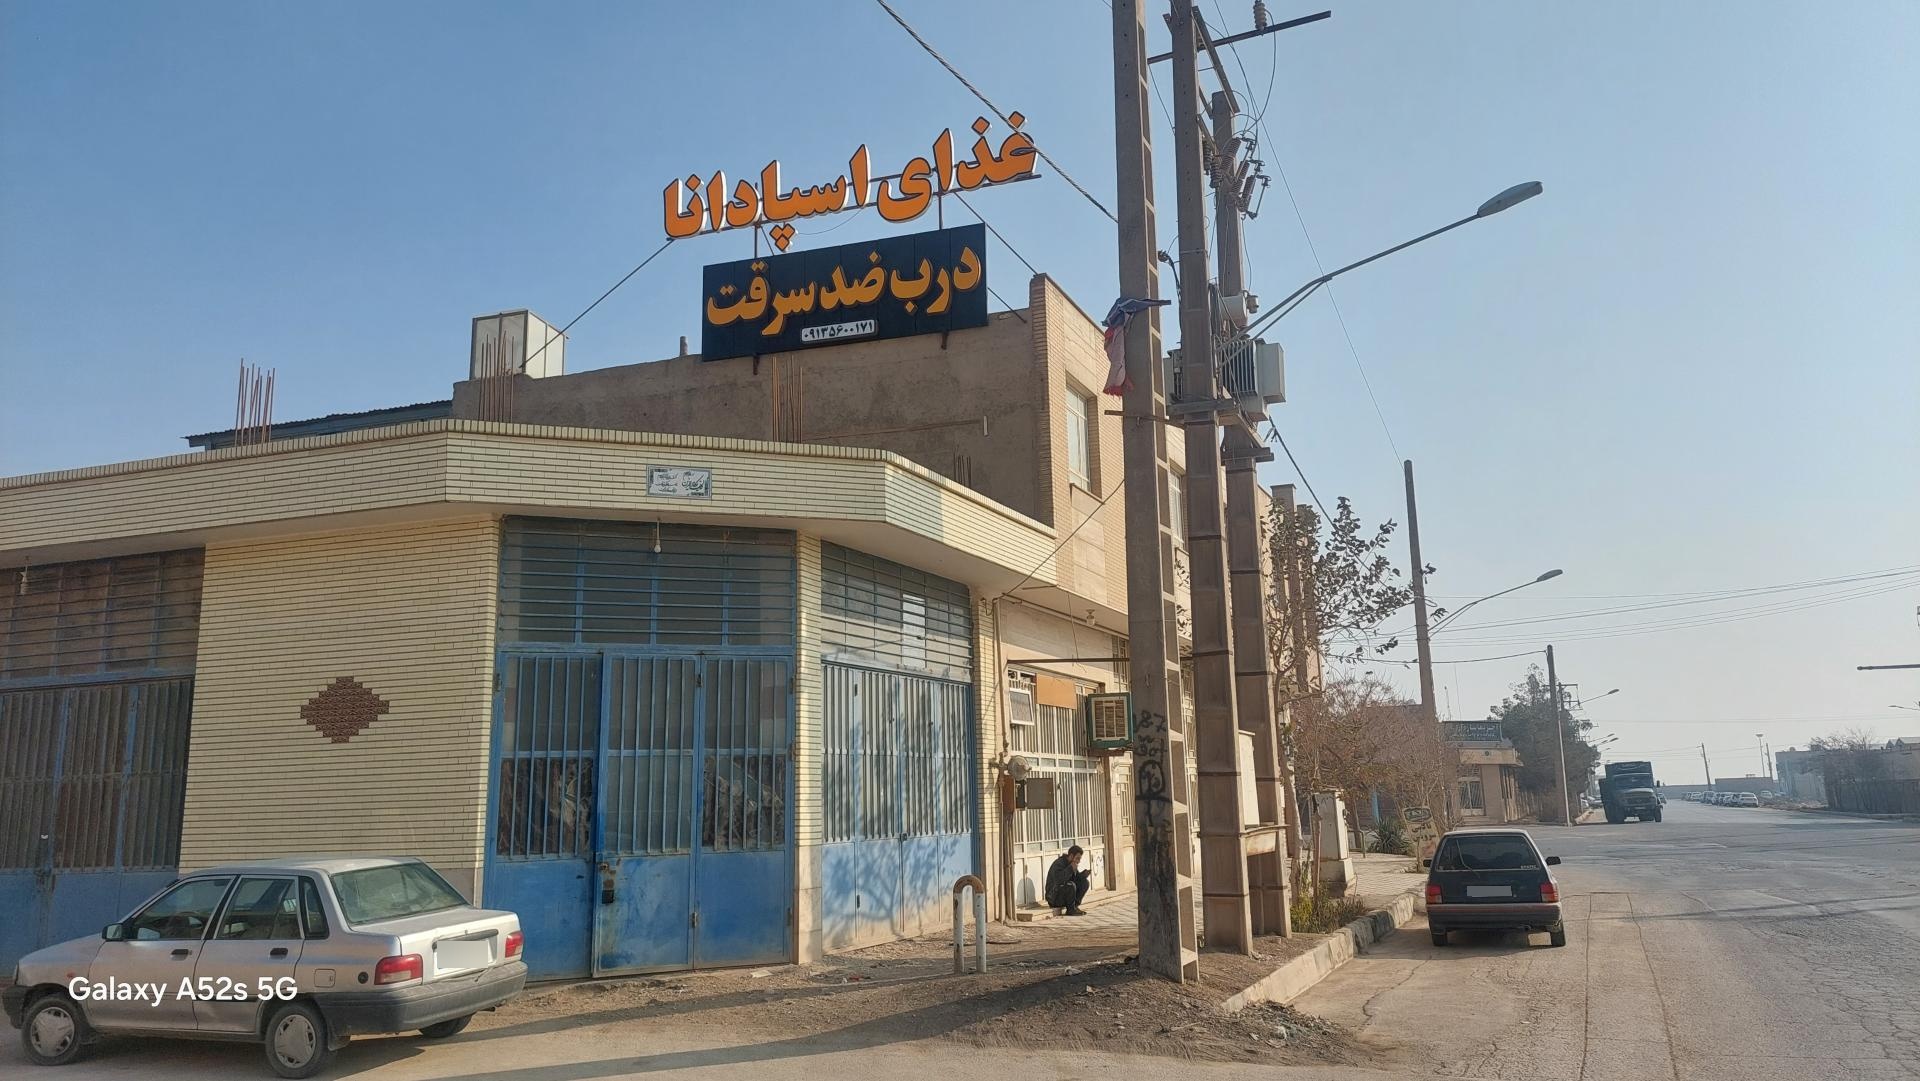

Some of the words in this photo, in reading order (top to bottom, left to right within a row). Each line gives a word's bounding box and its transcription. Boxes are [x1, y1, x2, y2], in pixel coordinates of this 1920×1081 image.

[663, 144, 871, 252] اسپادانا
[877, 111, 1038, 222] غذای
[706, 258, 816, 336] سرقت
[820, 251, 887, 311] ضد
[889, 246, 982, 314] درب
[803, 320, 874, 340] ۰۹۱۳۵۶۰۰۱۷۱
